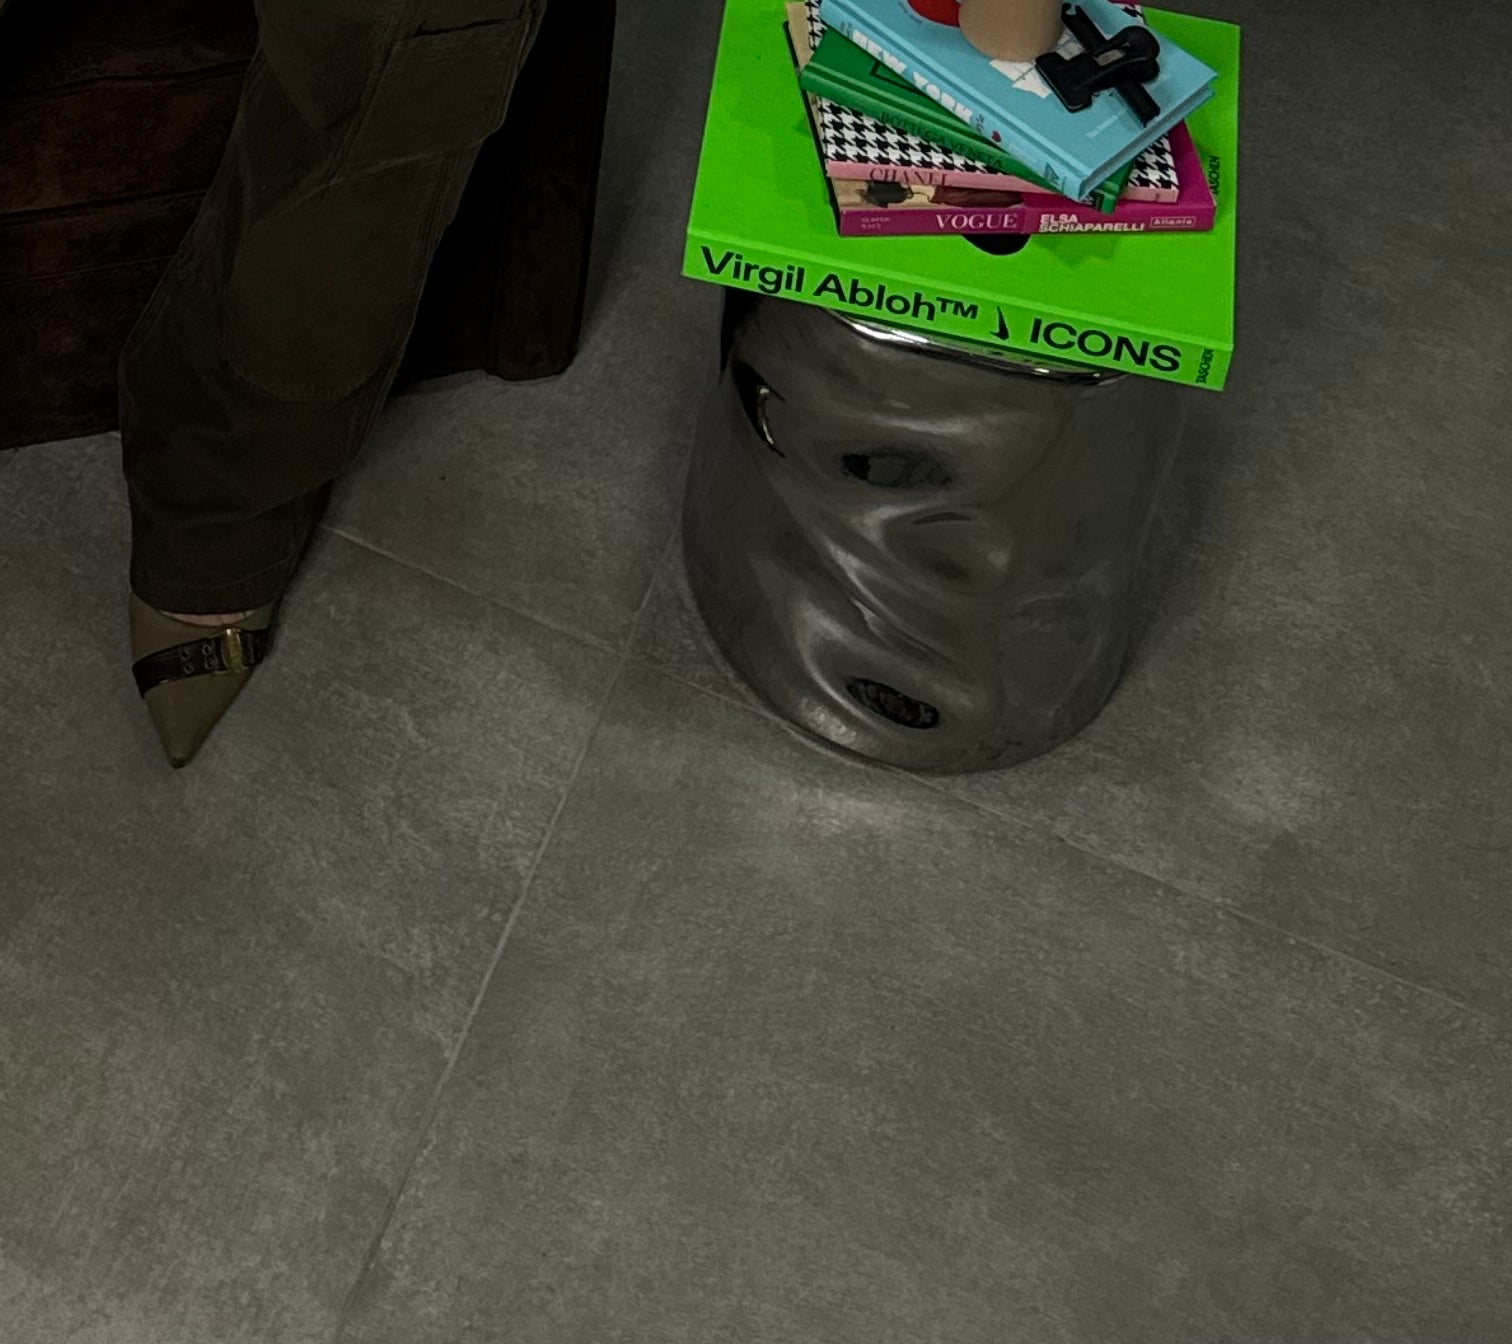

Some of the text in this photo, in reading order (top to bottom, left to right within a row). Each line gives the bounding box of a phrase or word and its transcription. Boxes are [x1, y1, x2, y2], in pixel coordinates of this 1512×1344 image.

[852, 28, 908, 76] NEW
[912, 70, 974, 125] YORK
[869, 167, 953, 188] CHANEL
[935, 213, 1019, 230] VOGUE
[1038, 220, 1145, 233] SCHIAPARELLI
[1039, 213, 1079, 224] ELSA
[700, 245, 1182, 372] Virgil Abloh™ ICONS
[1195, 348, 1215, 385] TASCHEN
